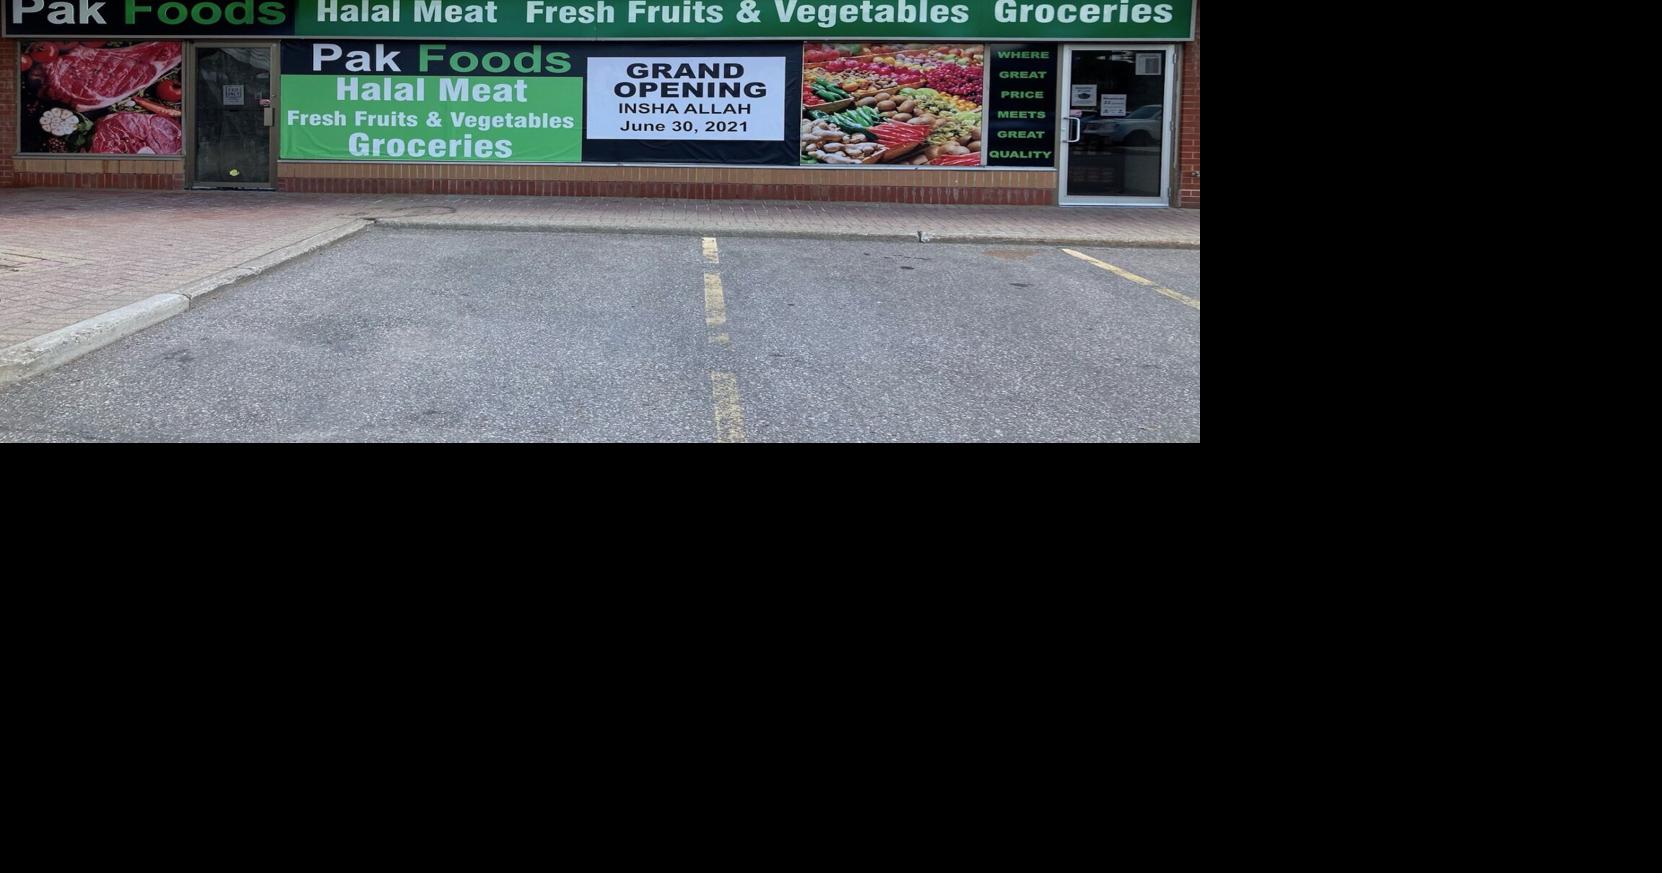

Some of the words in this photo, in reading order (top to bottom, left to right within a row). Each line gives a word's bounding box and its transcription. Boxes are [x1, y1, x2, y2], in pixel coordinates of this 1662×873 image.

[12, 0, 107, 25] Pak
[124, 0, 287, 25] Foods
[317, 0, 400, 22] Halal
[413, 0, 498, 23] Meat
[526, 0, 615, 24] Fresh
[627, 0, 724, 24] Fruits
[736, 0, 761, 24] &
[773, 0, 969, 28] Vegetables
[994, 0, 1174, 24] Groceries
[312, 43, 402, 72] Pak
[418, 44, 572, 73] Foods
[996, 51, 1049, 60] WHERE
[626, 62, 745, 80] GRAND
[999, 71, 1047, 79] GREAT
[336, 77, 425, 102] Halal
[438, 78, 528, 103] Meat
[613, 81, 767, 99] OPENING
[1001, 91, 1044, 99] PRICE
[618, 102, 680, 115] INSHA
[683, 103, 751, 116] ALLAH
[997, 111, 1046, 119] MEETS
[287, 110, 347, 126] Fresh
[354, 110, 418, 128] Fruits
[426, 111, 442, 128] &
[450, 111, 575, 131] Vegetables
[619, 120, 667, 133] June
[672, 120, 699, 135] 30,
[704, 120, 748, 133] 2021
[997, 131, 1045, 139] GREAT
[348, 132, 513, 159] Groceries
[989, 151, 1052, 159] QUALITY
